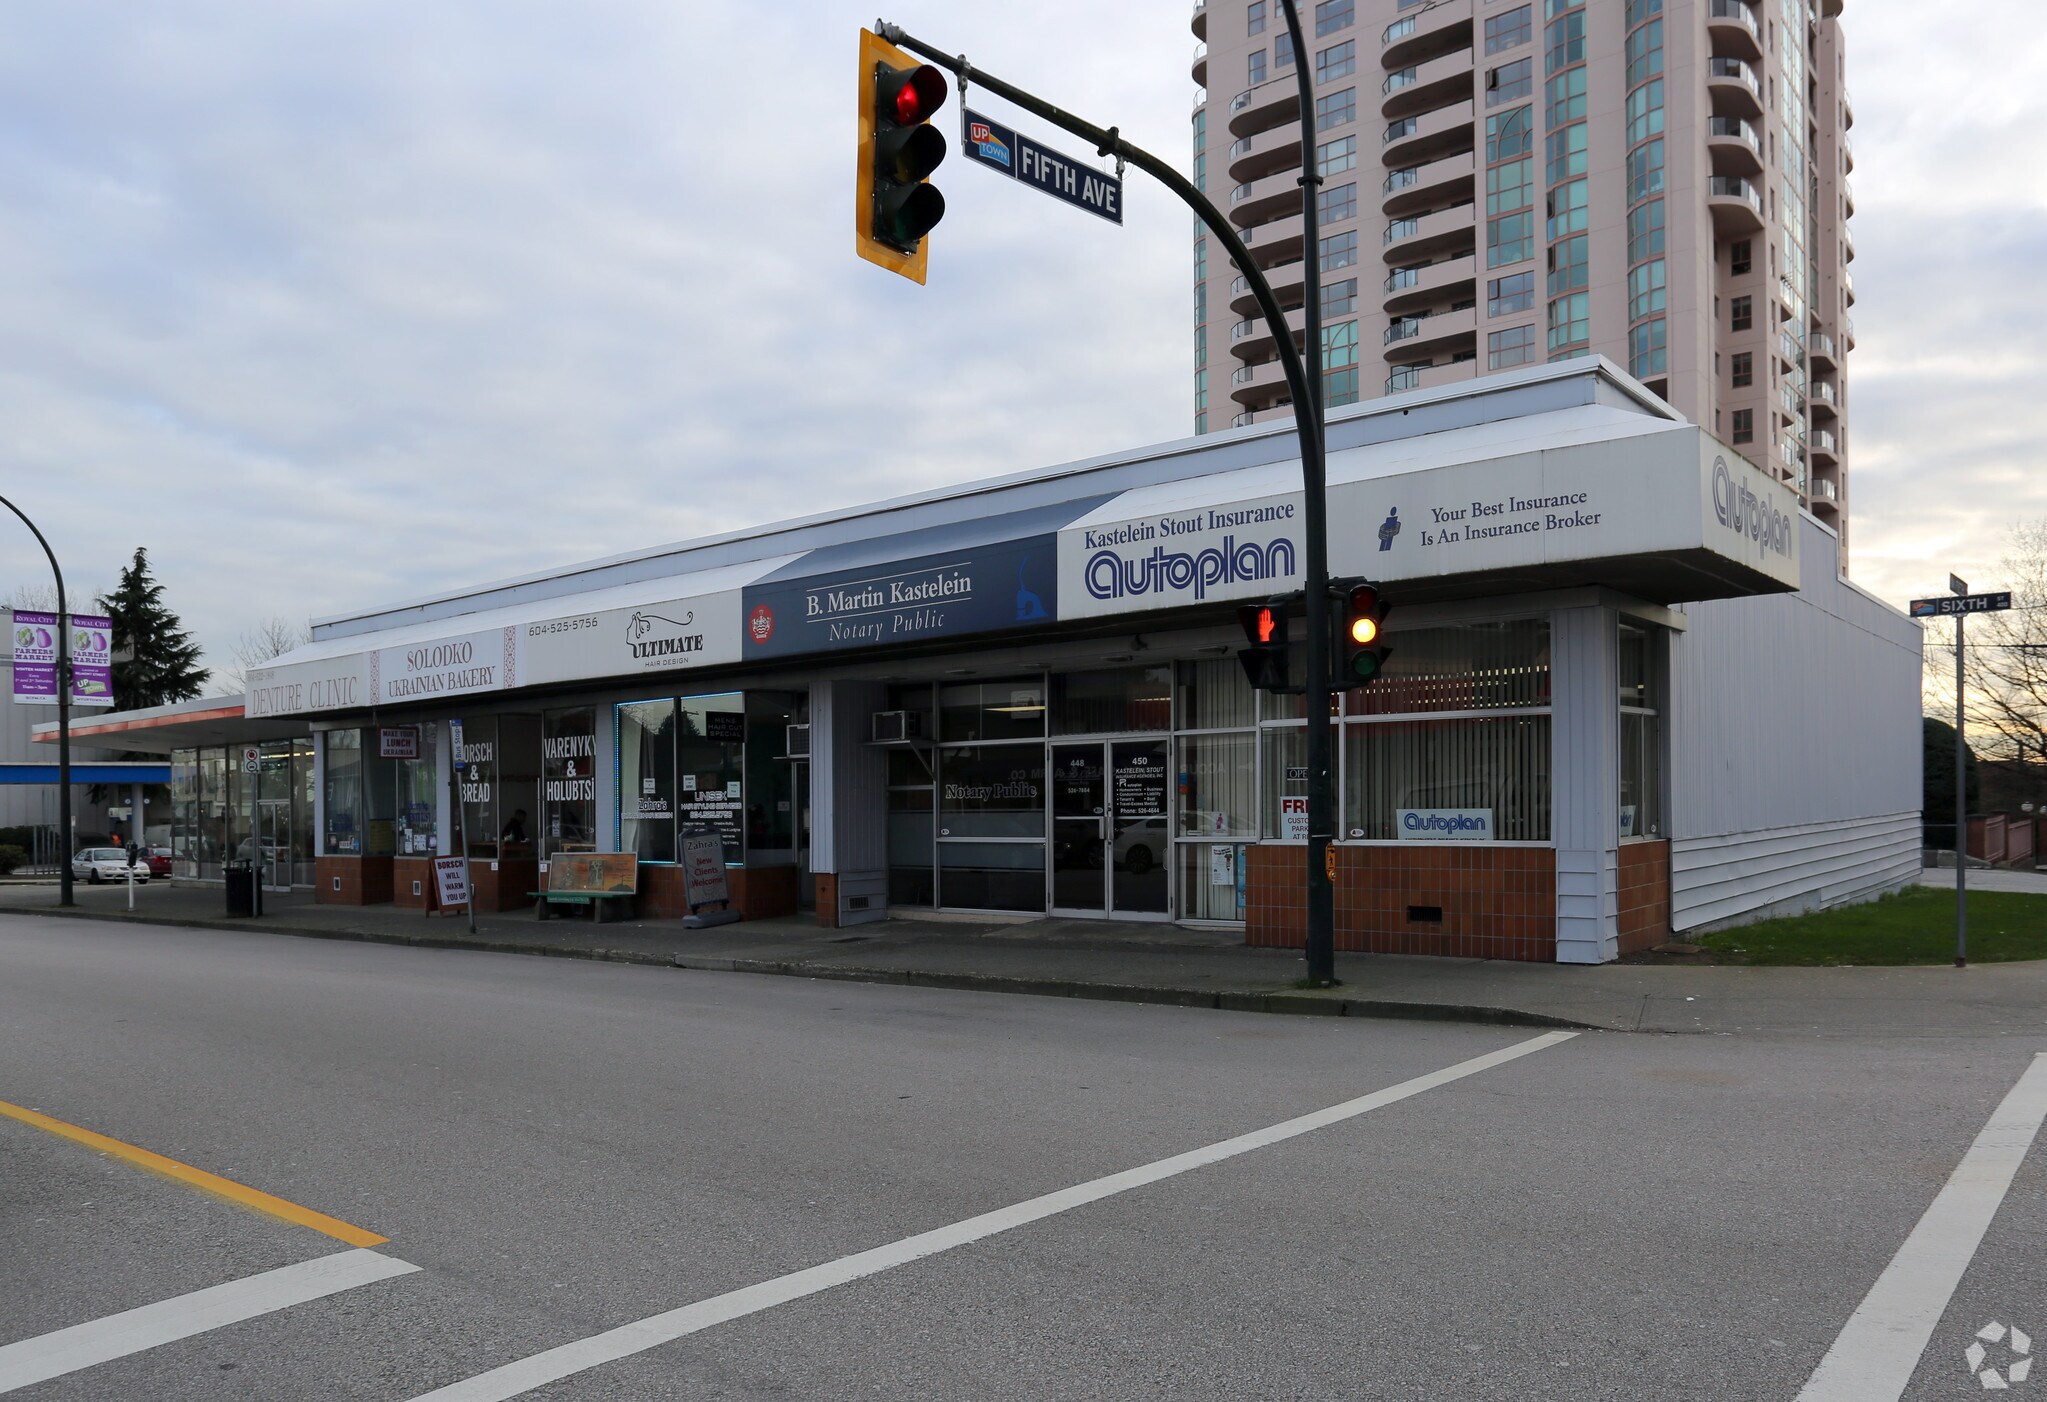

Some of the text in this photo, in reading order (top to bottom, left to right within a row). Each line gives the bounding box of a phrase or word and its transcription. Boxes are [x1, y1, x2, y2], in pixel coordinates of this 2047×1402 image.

[973, 126, 989, 139] UP
[981, 143, 1008, 161] TOWN
[1022, 145, 1117, 213] FIFTH AVE
[1431, 492, 1588, 524] Your Best Insurance
[1084, 503, 1295, 550] Kastelein Stout Insurance
[1420, 510, 1602, 547] Is An Insurance Broker
[806, 571, 972, 616] B. Martin Kastelein
[1941, 597, 1988, 612] SIXTH
[16, 615, 54, 624] ROYAL CITY
[74, 618, 94, 627] ROYAL
[829, 609, 945, 641] Notary Public
[529, 617, 598, 637] 604-525-5756
[15, 647, 54, 655] FARMERS
[632, 634, 703, 659] ULTIMATE
[73, 650, 108, 658] FARMERS
[73, 656, 109, 664] MARKET
[407, 641, 473, 672] SOLODKO
[645, 657, 689, 668] HAIR DESIGN
[77, 679, 89, 688] UP
[388, 666, 496, 698] UKRAINIAN BAKERY
[252, 676, 357, 715] DENTURE CLINIC
[454, 728, 462, 745] Stop
[386, 739, 411, 748] LUNCH
[544, 735, 597, 759] VARENYKY
[463, 742, 493, 763] ORSCH
[1070, 759, 1085, 767] 448
[1132, 757, 1148, 765] 450
[470, 765, 479, 781] &
[566, 760, 577, 778] &
[1289, 769, 1308, 778] OPE
[694, 790, 728, 802] UNISEX
[945, 781, 1037, 803] Notary Public
[638, 797, 668, 811] Zahra's
[687, 840, 719, 851] Zahra's
[437, 860, 464, 870] BORSCH
[696, 857, 712, 865] New
[445, 872, 460, 880] WILL
[694, 867, 718, 876] Clients
[445, 882, 464, 890] WARM
[691, 877, 723, 888] Welcome
[446, 892, 467, 901] YOU UP
